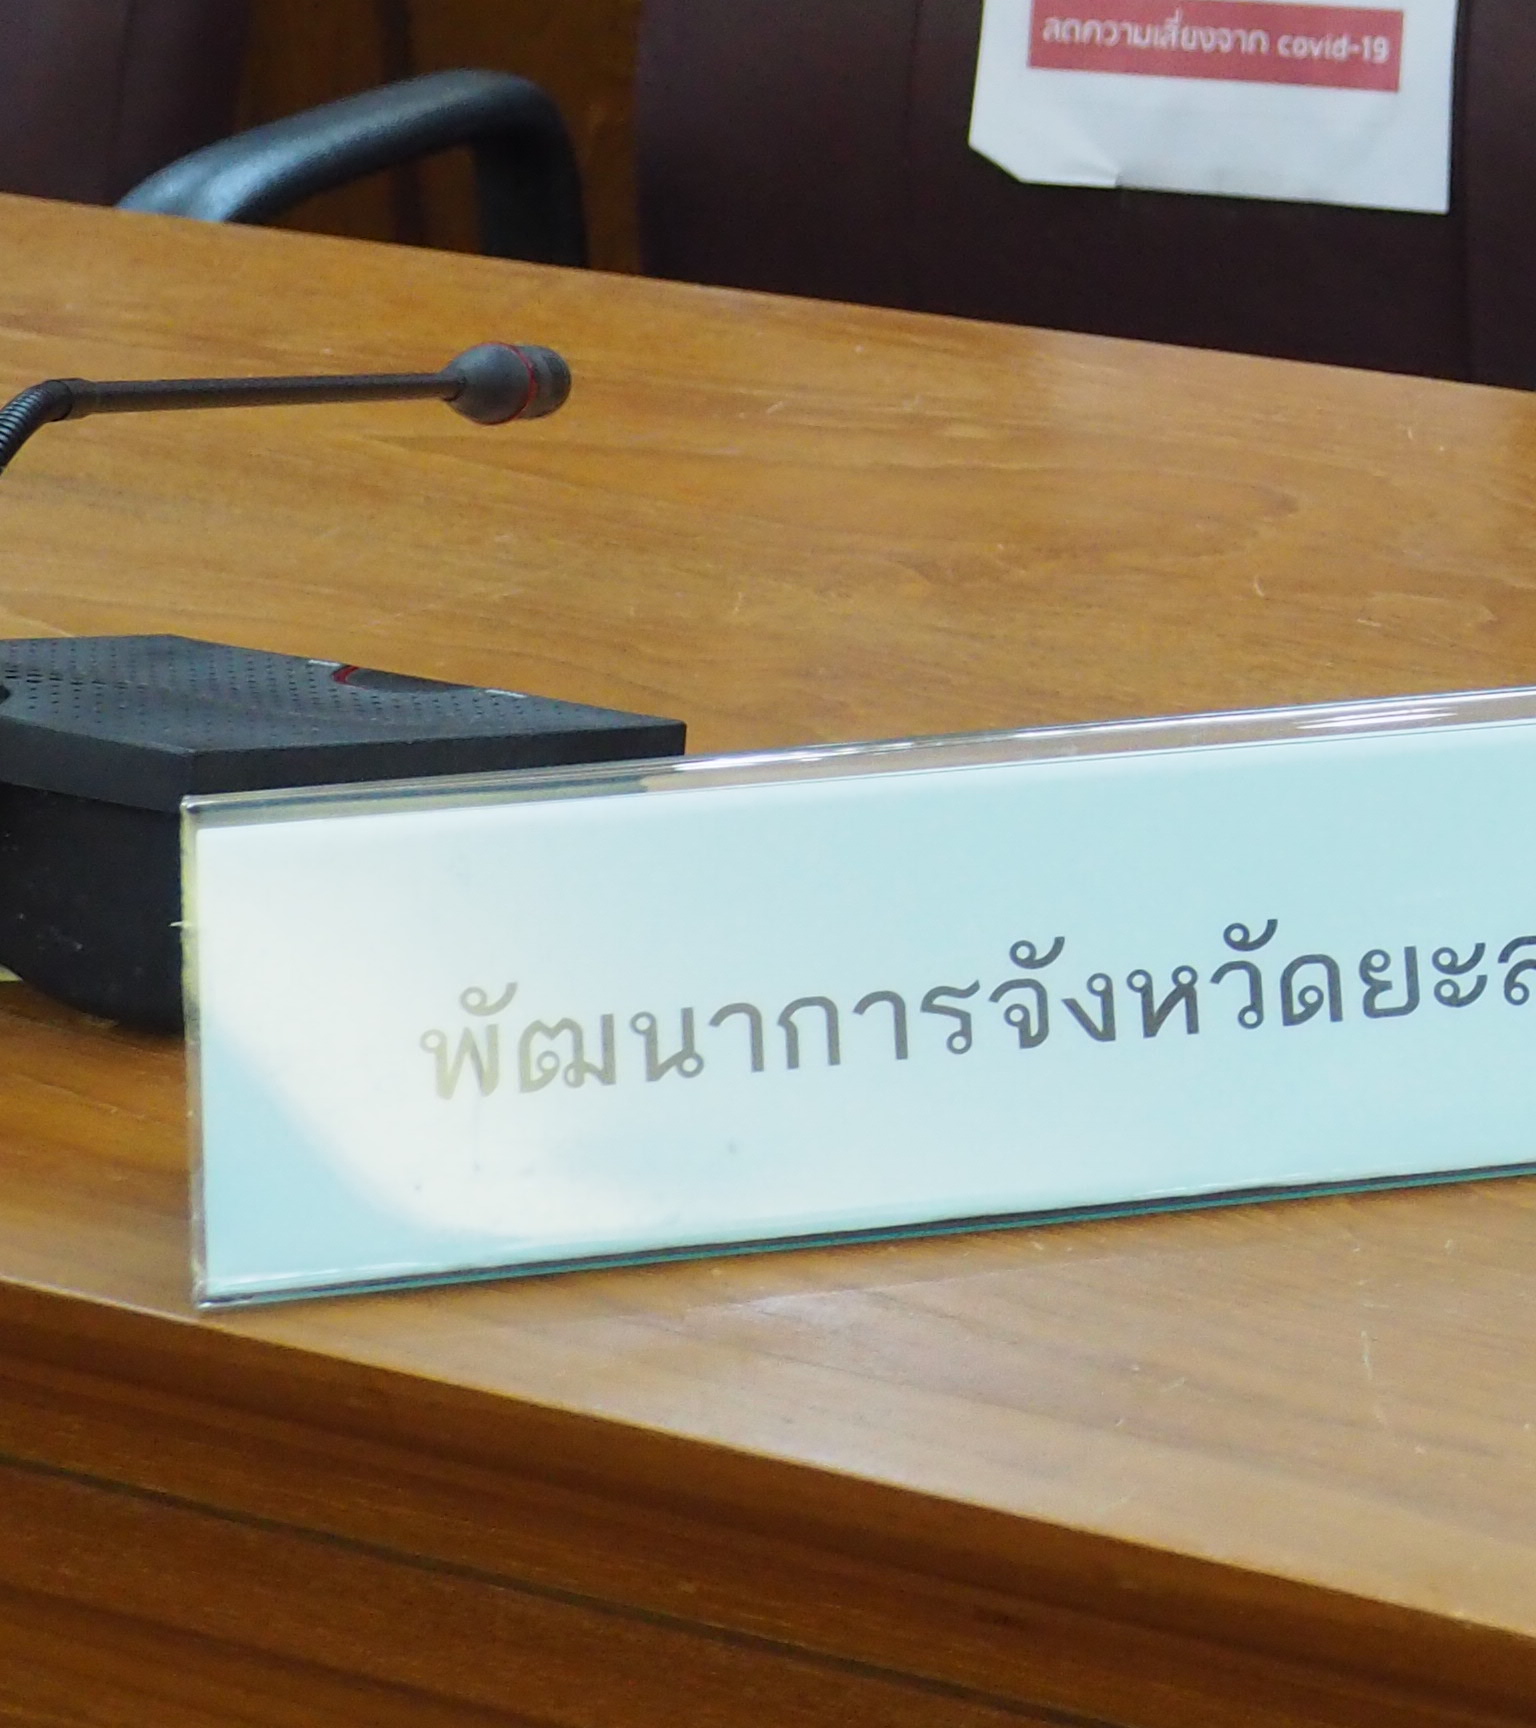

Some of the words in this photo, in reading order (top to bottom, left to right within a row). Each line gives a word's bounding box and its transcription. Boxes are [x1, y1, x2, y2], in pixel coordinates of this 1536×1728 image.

[1041, 7, 1271, 55] ลดความเสี่ยงจาก
[1276, 34, 1391, 64] covid-19
